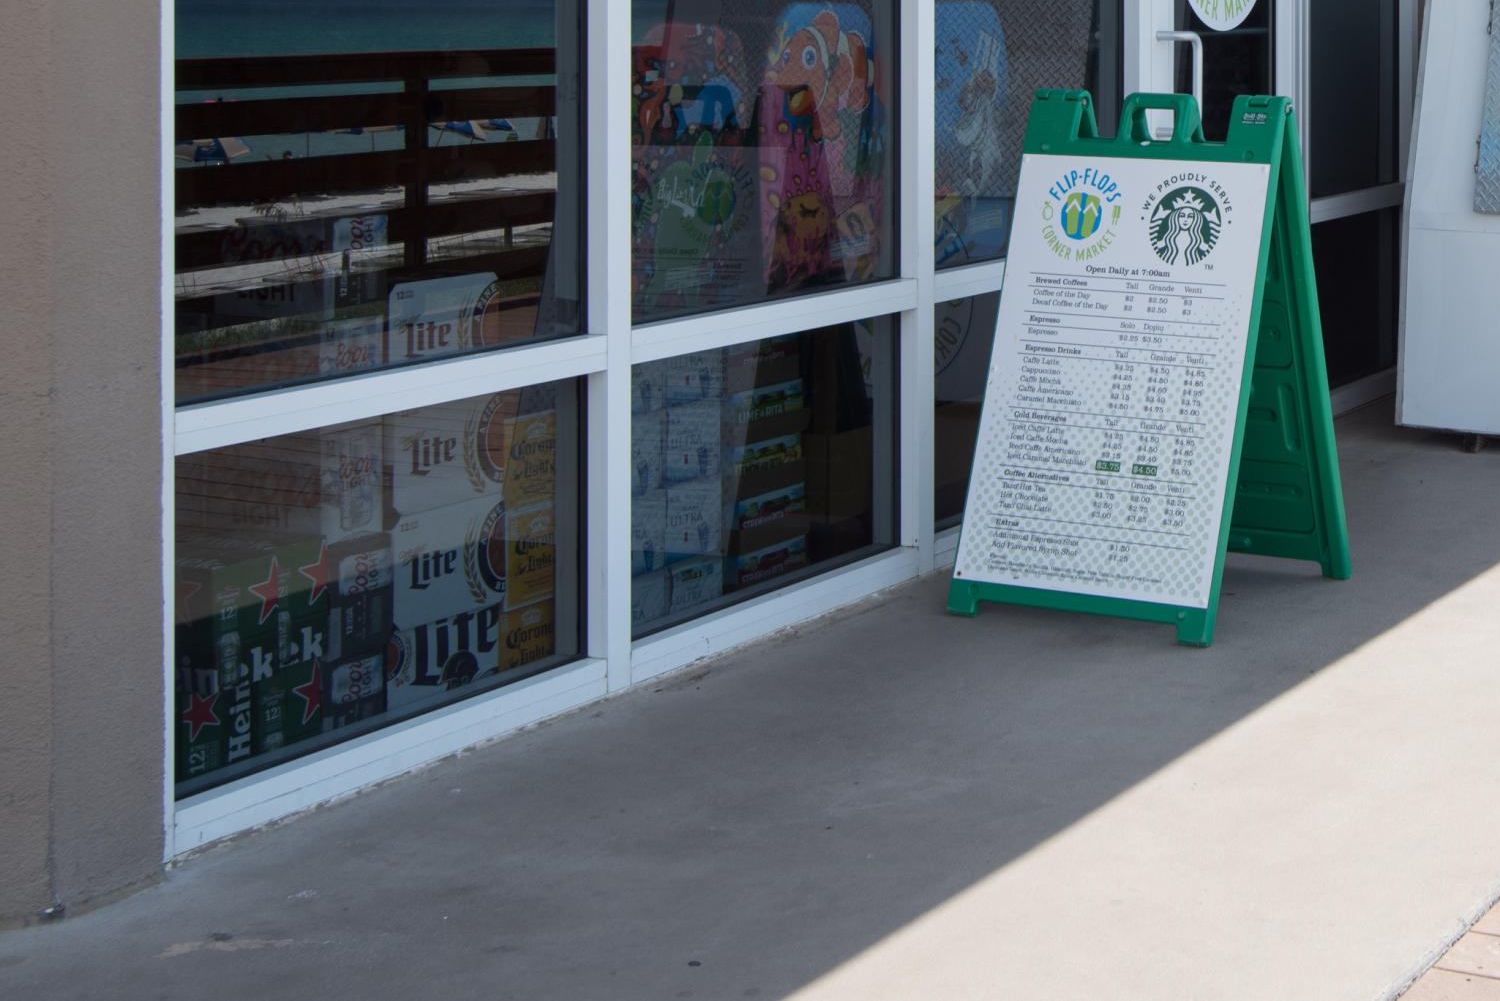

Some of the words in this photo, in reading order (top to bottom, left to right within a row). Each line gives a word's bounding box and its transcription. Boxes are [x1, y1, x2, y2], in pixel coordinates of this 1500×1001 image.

[1049, 168, 1121, 203] FLIP-FLOPS
[1142, 193, 1154, 211] WE
[1157, 173, 1207, 192] PROUDLY
[1209, 180, 1233, 213] SERVE
[1042, 224, 1070, 260] CORNER
[1075, 229, 1116, 262] MARKET
[1086, 265, 1106, 274] Open
[1108, 266, 1129, 276] Daily
[1142, 269, 1170, 277] 7:00am
[1035, 277, 1061, 285] Brewed
[1062, 279, 1087, 287] Coffees
[1149, 284, 1174, 292] Grande
[1033, 289, 1054, 297] Coffee
[1056, 290, 1063, 299] of
[1077, 292, 1091, 300] Day
[1074, 301, 1082, 309] of
[1095, 303, 1109, 311] Day
[1029, 315, 1060, 324] Espresso
[1120, 321, 1135, 329] Solo
[1028, 327, 1057, 336] Espresso
[398, 321, 452, 359] Lite
[1025, 344, 1056, 354] Espresso
[1057, 347, 1081, 355] Drinks
[1116, 351, 1128, 359] Tall
[1151, 354, 1176, 362] Grande
[1187, 356, 1204, 364] Venti
[1042, 358, 1059, 366] Latte
[1021, 366, 1060, 376] Cappuccino
[1039, 377, 1061, 385] Mocha
[1037, 386, 1073, 396] Americano
[1017, 394, 1045, 403] Caramel
[1047, 396, 1081, 406] Macchiato
[1014, 411, 1030, 419] Cold
[1032, 413, 1066, 422] Beverages
[1140, 422, 1166, 430] Grande
[1176, 425, 1194, 433] Venti
[403, 435, 457, 476] Lite
[1004, 469, 1028, 478] Coffee
[1030, 472, 1069, 482] Alternatives
[1131, 482, 1157, 490] Grande
[1167, 485, 1184, 493] Venti
[402, 549, 457, 590] Lite
[410, 602, 500, 686] Lite
